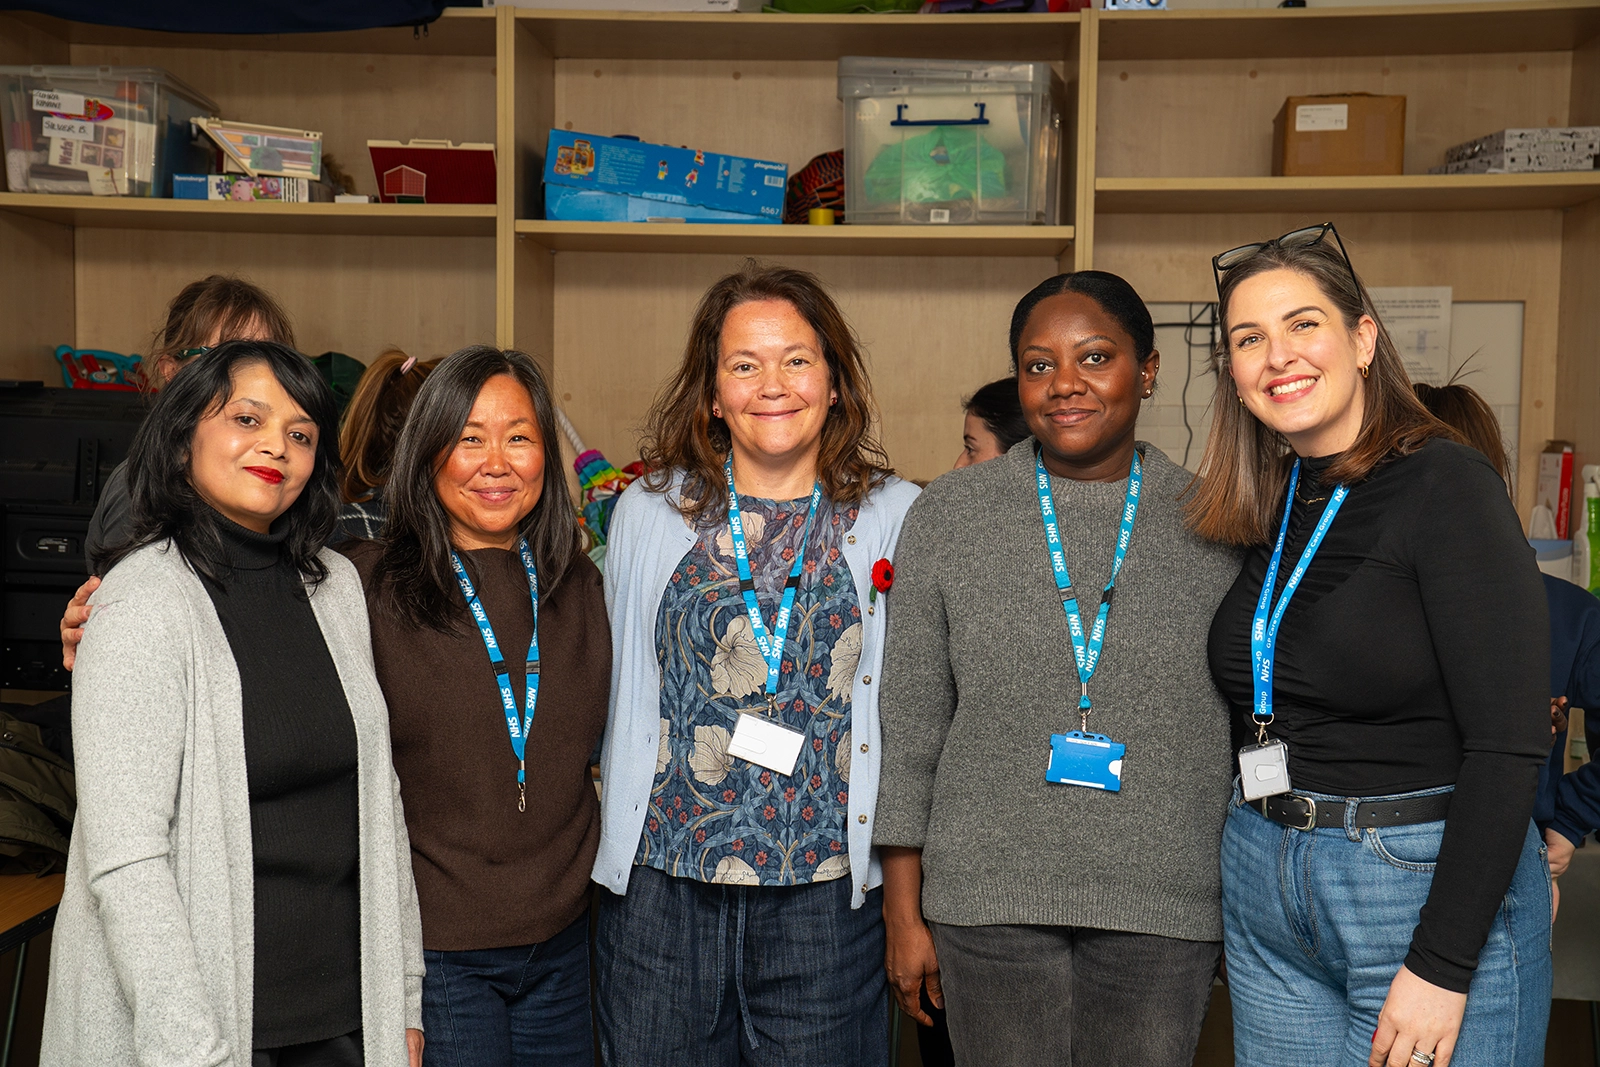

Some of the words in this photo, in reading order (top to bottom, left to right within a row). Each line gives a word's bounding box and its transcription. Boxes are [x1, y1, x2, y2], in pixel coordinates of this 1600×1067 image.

[44, 121, 75, 133] SILVER
[1038, 473, 1048, 490] NHS
[1130, 479, 1140, 497] NHS
[728, 492, 738, 510] NHS
[1041, 496, 1052, 516] NHS
[1124, 502, 1135, 524] NHS
[730, 516, 742, 534] NHS
[1046, 522, 1058, 544] NHS
[1304, 548, 1312, 558] GP
[1310, 532, 1322, 548] Care
[1318, 509, 1334, 531] Group
[735, 540, 746, 559] NHS
[1120, 528, 1130, 551] NHS
[1052, 551, 1064, 572] NHS
[1288, 566, 1304, 589] NHS
[1260, 588, 1270, 610] Group
[1274, 596, 1288, 618] Group
[470, 602, 486, 622] NHS
[749, 608, 762, 629] NHS
[778, 606, 790, 630] NHS
[1068, 614, 1082, 636] NHS
[1092, 618, 1104, 642] NHS
[1254, 618, 1264, 641] NHS
[1268, 619, 1278, 636] Care
[482, 628, 496, 648] NHS
[757, 636, 770, 656] NHS
[771, 636, 784, 660] NHS
[1266, 638, 1272, 648] GP
[1076, 645, 1086, 668] NHS
[1085, 648, 1098, 672] NHS
[1260, 658, 1270, 682] NHS
[502, 688, 514, 710] NHS
[527, 687, 536, 710] NHS
[1259, 691, 1268, 714] Group
[508, 716, 520, 738] NHS
[524, 716, 532, 738] NHS
